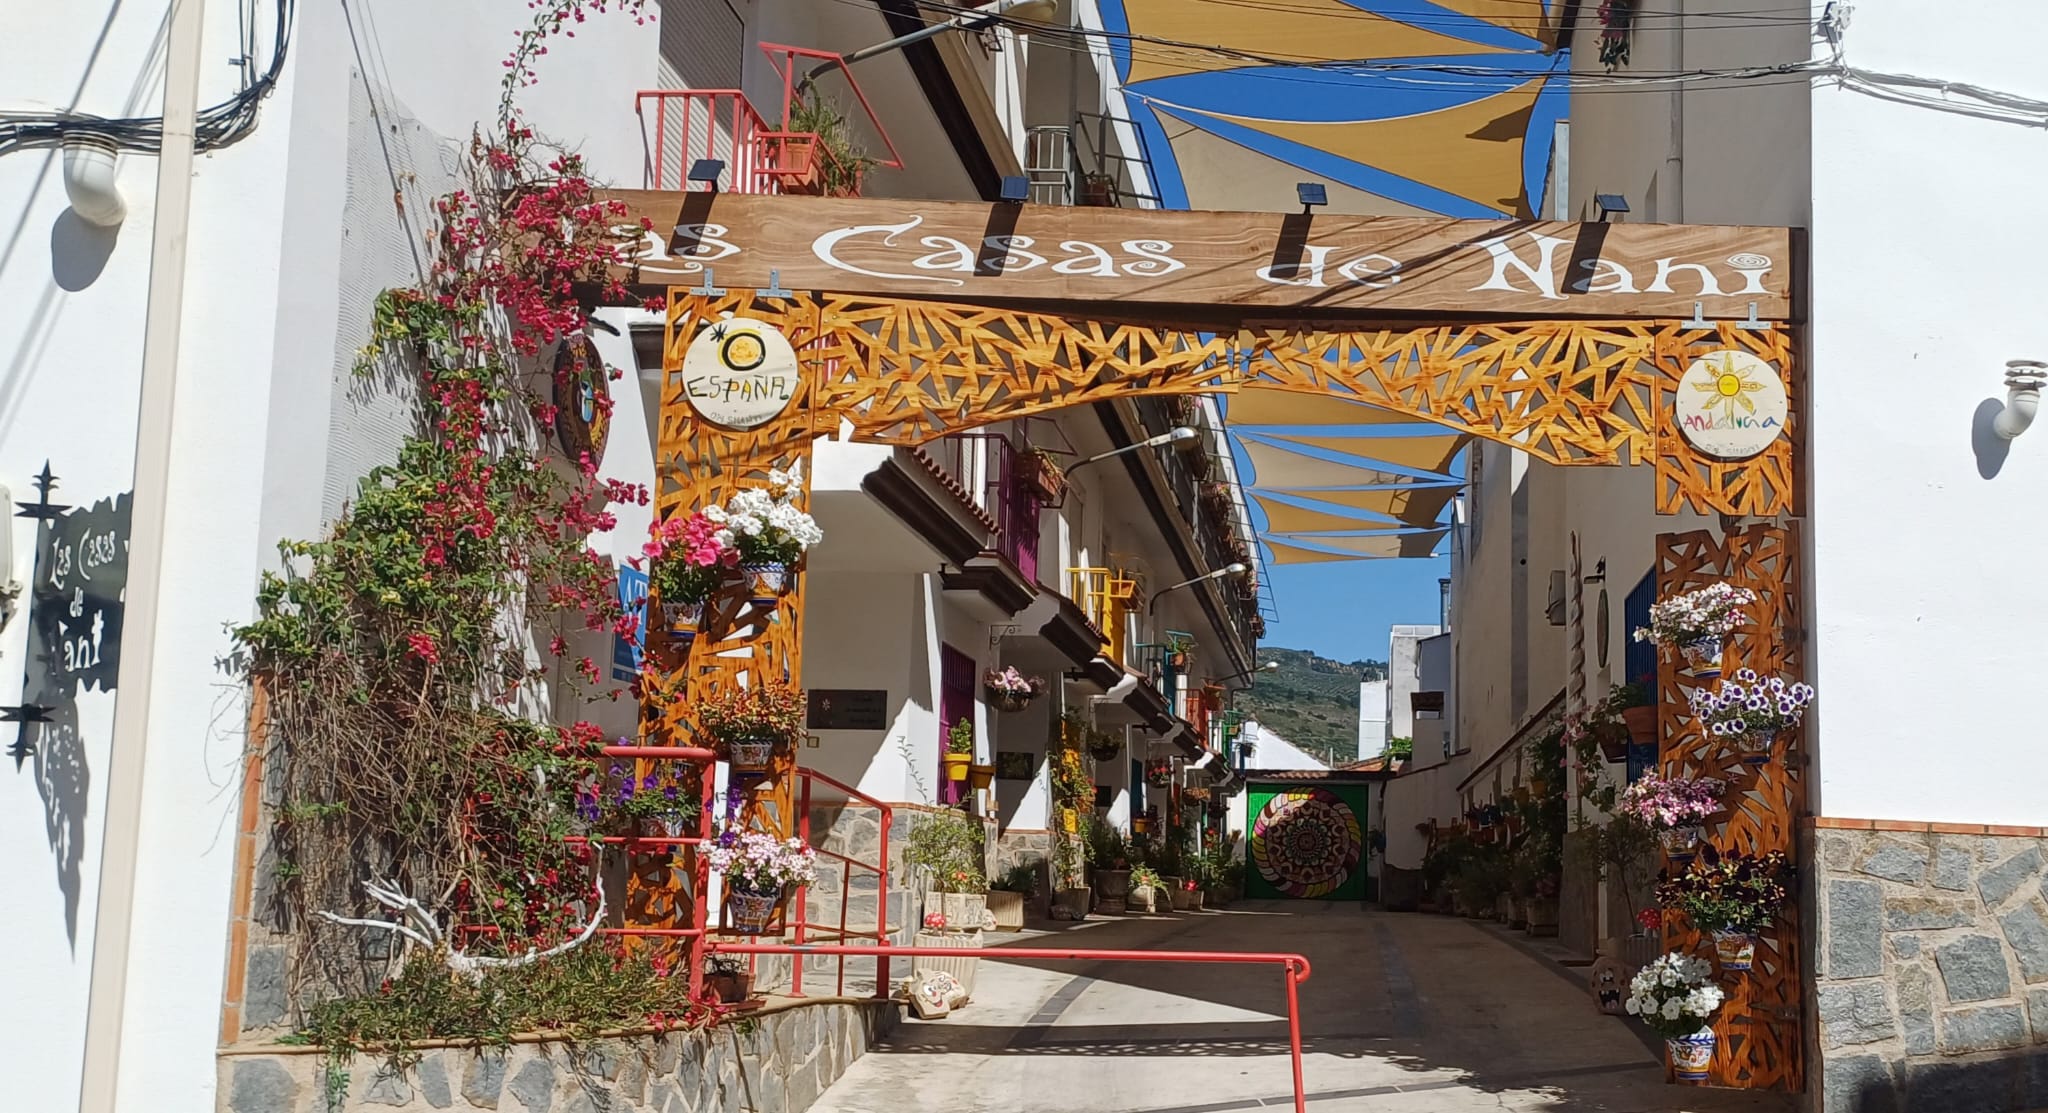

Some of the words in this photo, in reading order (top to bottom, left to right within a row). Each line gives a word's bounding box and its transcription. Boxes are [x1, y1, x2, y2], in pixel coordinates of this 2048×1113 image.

[811, 215, 1186, 286] Casas
[1256, 244, 1402, 288] de
[1456, 231, 1774, 300] Nani
[687, 374, 789, 403] ESPAÑA
[49, 537, 71, 590] Las
[78, 528, 115, 580] Casas
[69, 586, 84, 617] de
[51, 609, 104, 673] ani
